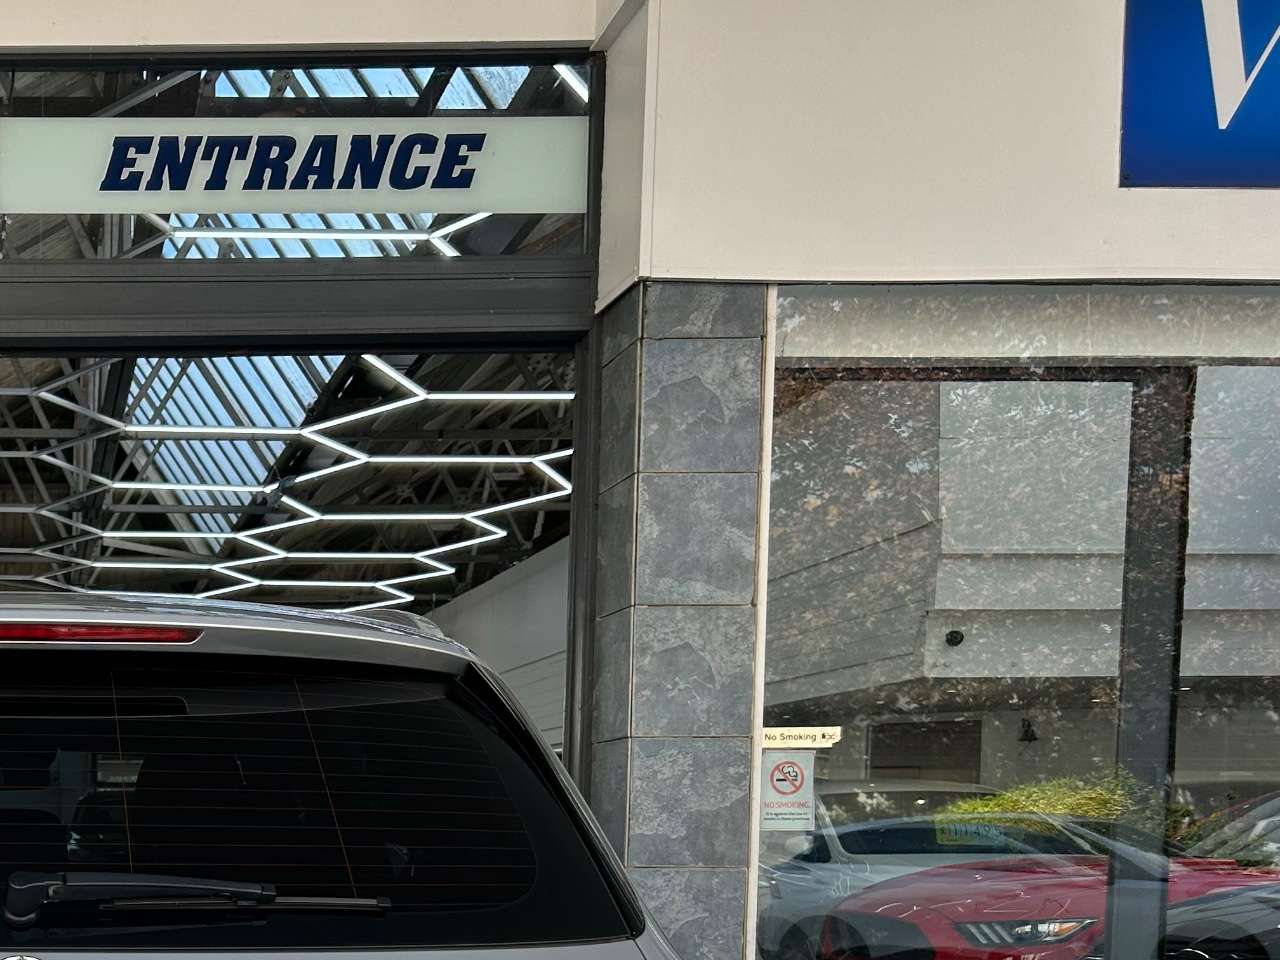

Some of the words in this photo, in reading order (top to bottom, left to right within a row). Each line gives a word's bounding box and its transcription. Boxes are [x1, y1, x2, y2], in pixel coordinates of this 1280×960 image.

[99, 133, 487, 191] ENTRANCE
[764, 733, 777, 741] No
[780, 733, 817, 742] Smoking
